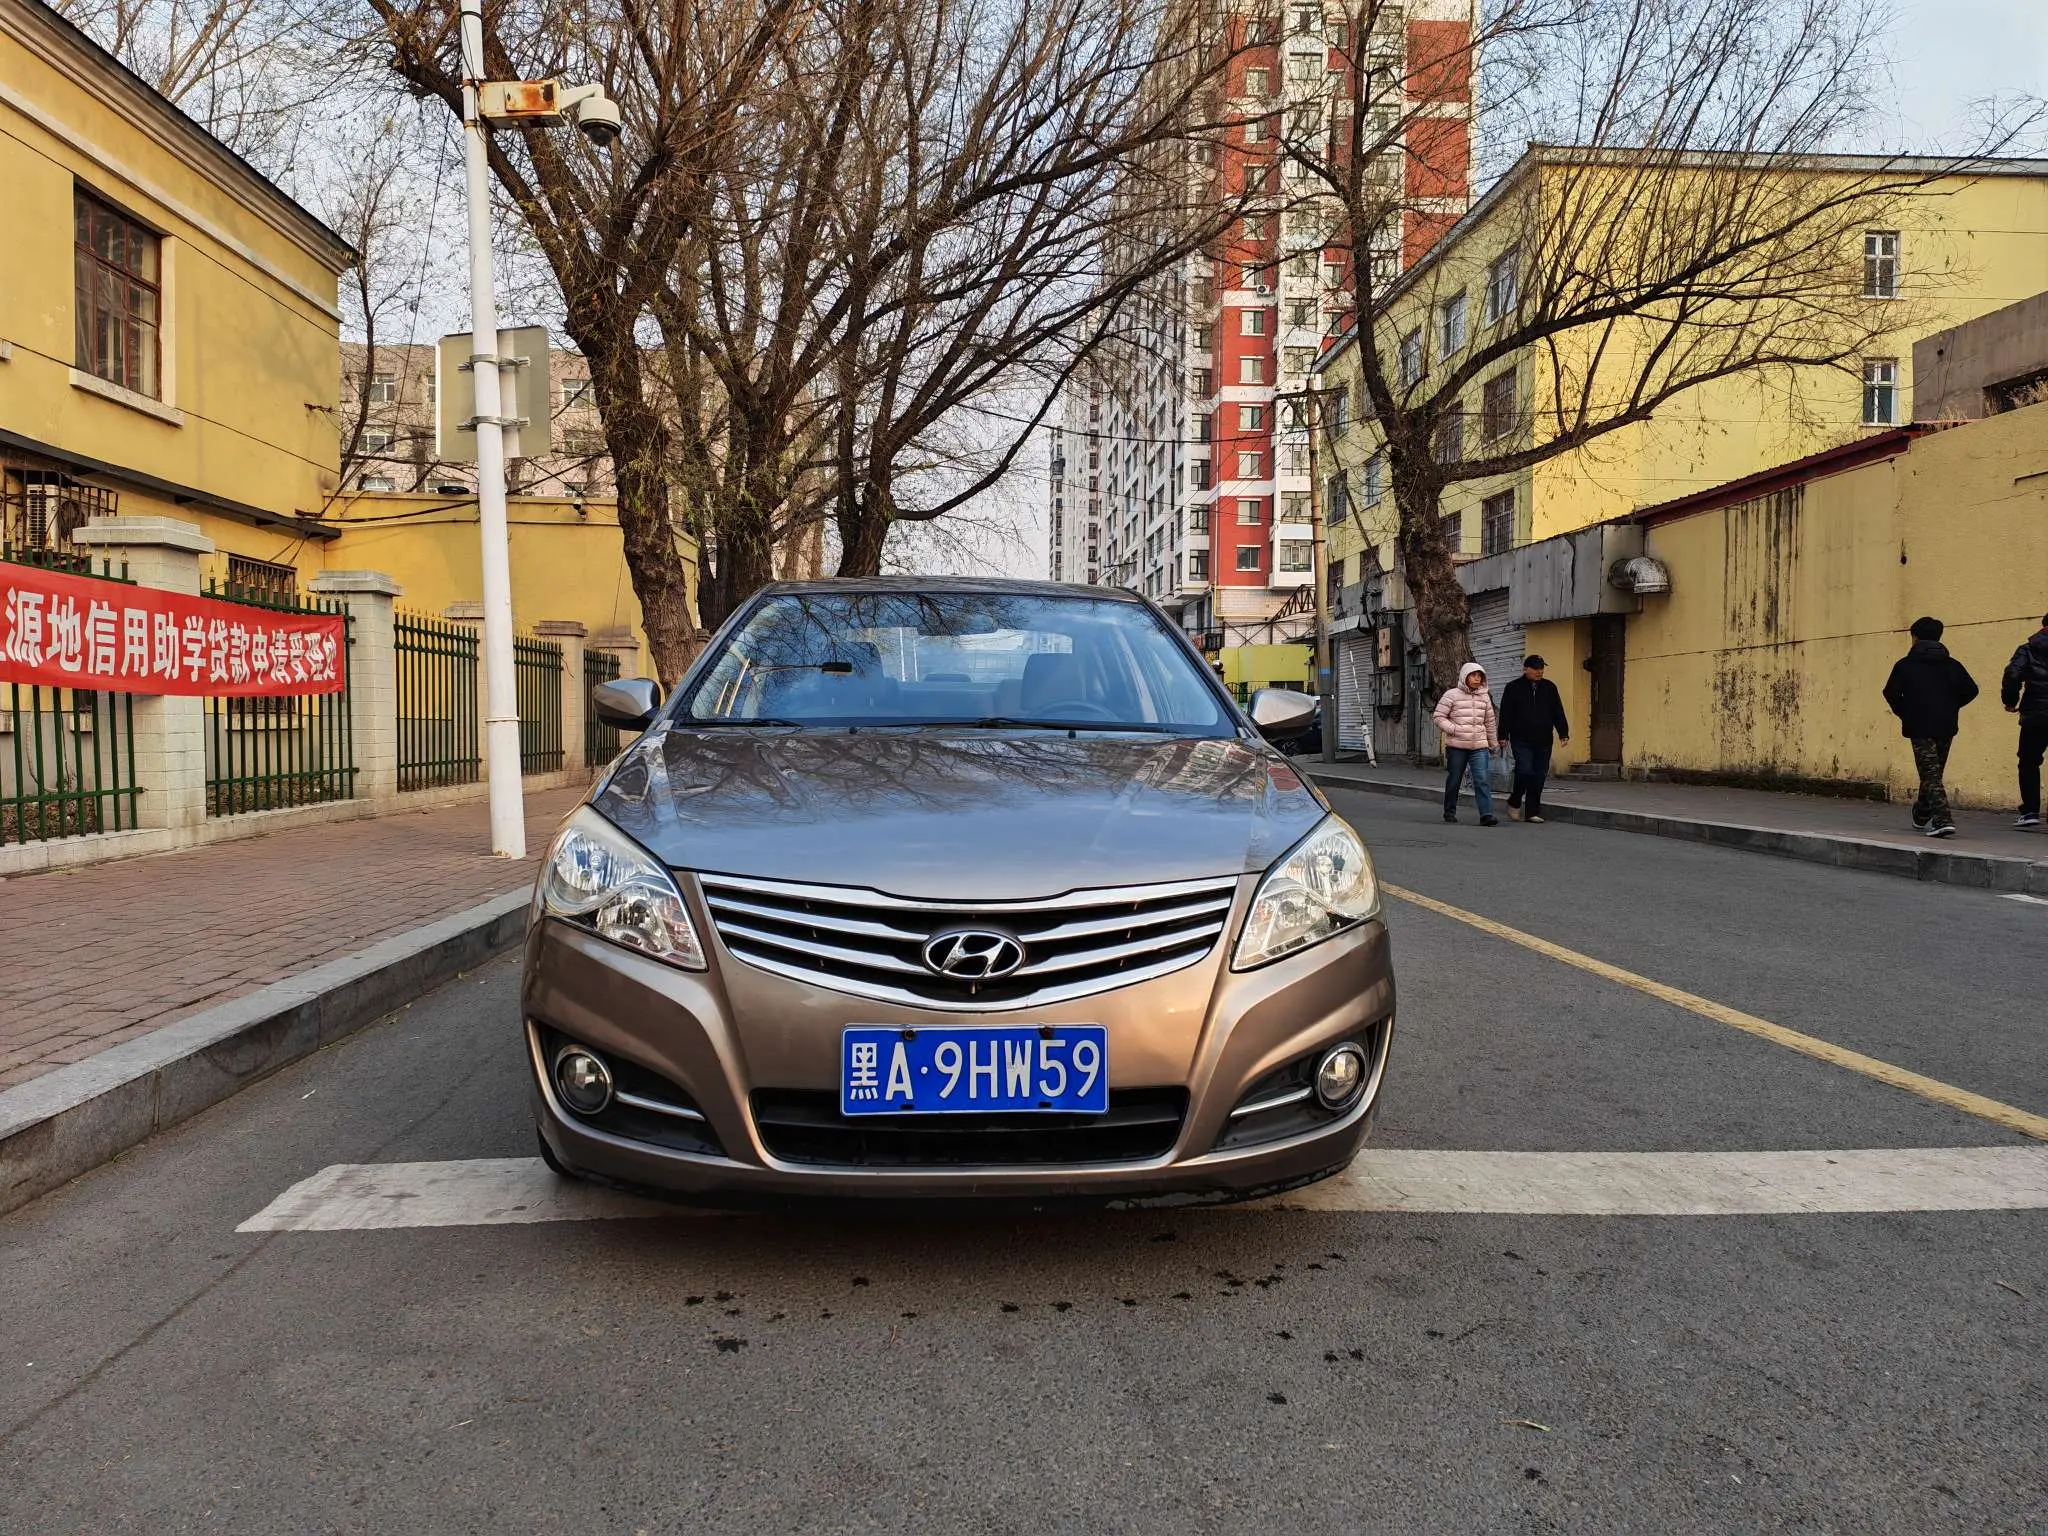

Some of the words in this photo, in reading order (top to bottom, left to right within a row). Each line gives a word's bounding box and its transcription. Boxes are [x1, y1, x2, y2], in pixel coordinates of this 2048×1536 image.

[0, 586, 337, 685] 源地信用助学贷款申请受理处
[849, 1039, 1101, 1101] 黑A·9HW59
